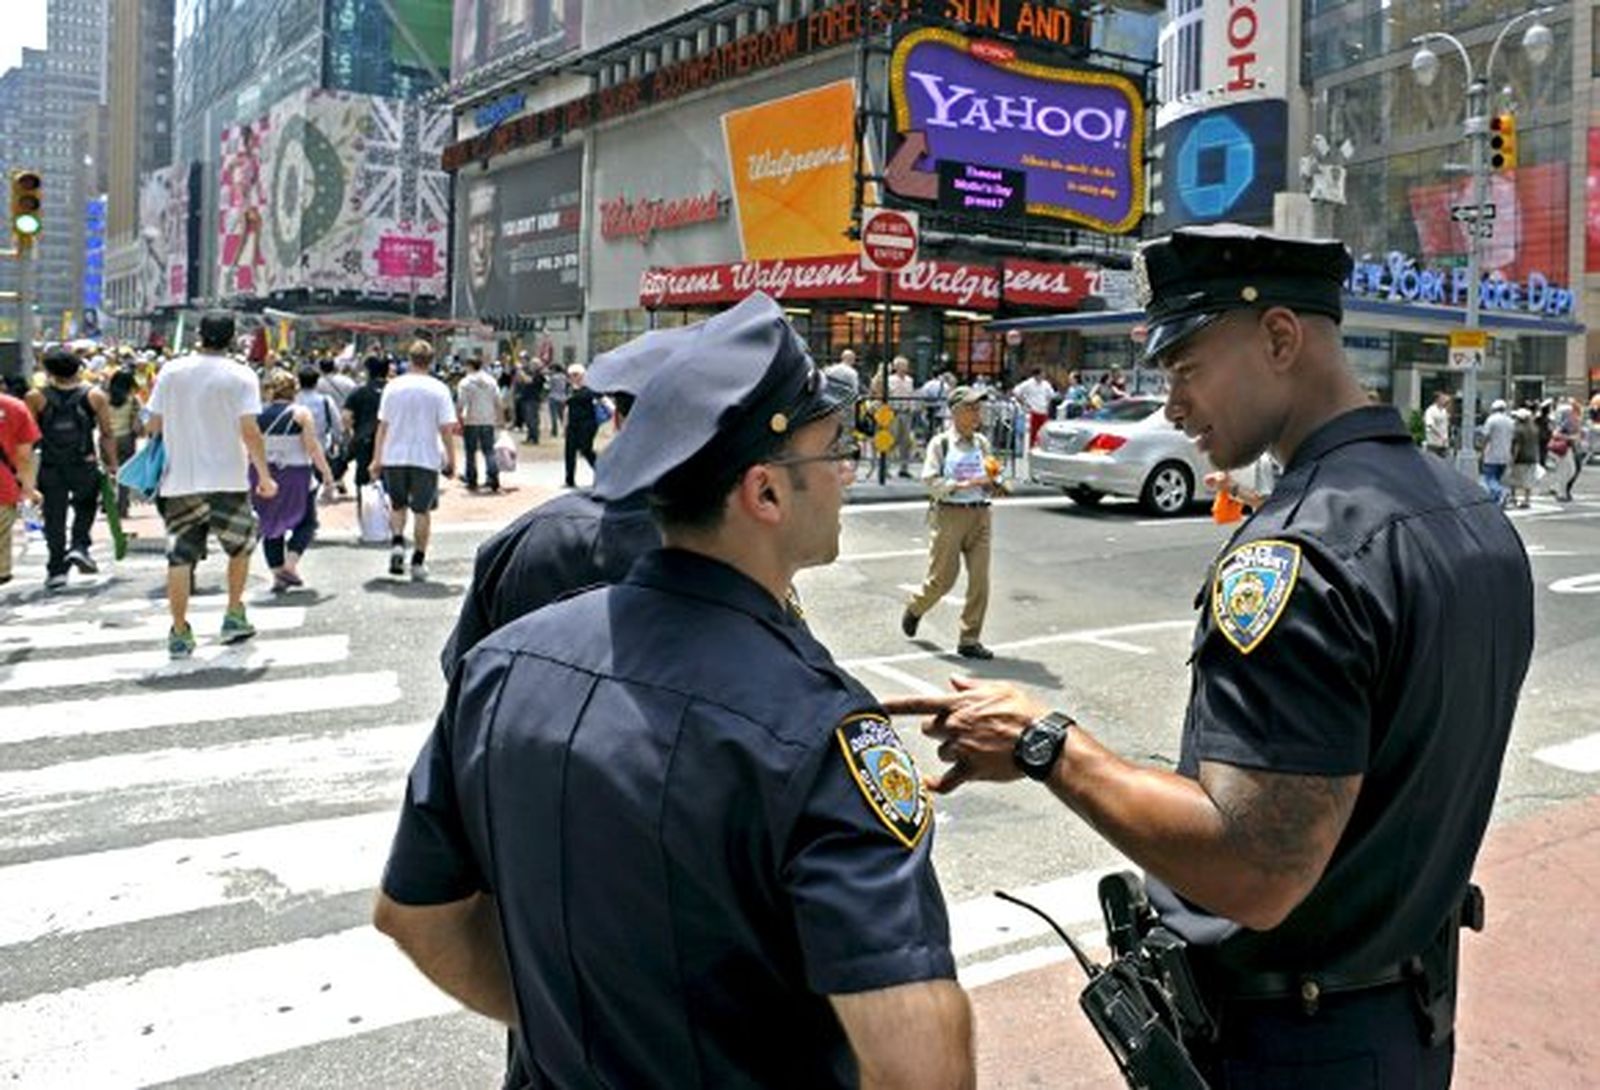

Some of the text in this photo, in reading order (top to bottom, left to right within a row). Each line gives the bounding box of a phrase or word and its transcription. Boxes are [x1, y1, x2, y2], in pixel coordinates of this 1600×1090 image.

[1017, 3, 1071, 45] AND
[909, 71, 1127, 148] YAHOO!
[748, 143, 849, 184] Walgreens
[730, 260, 868, 297] Walgreens
